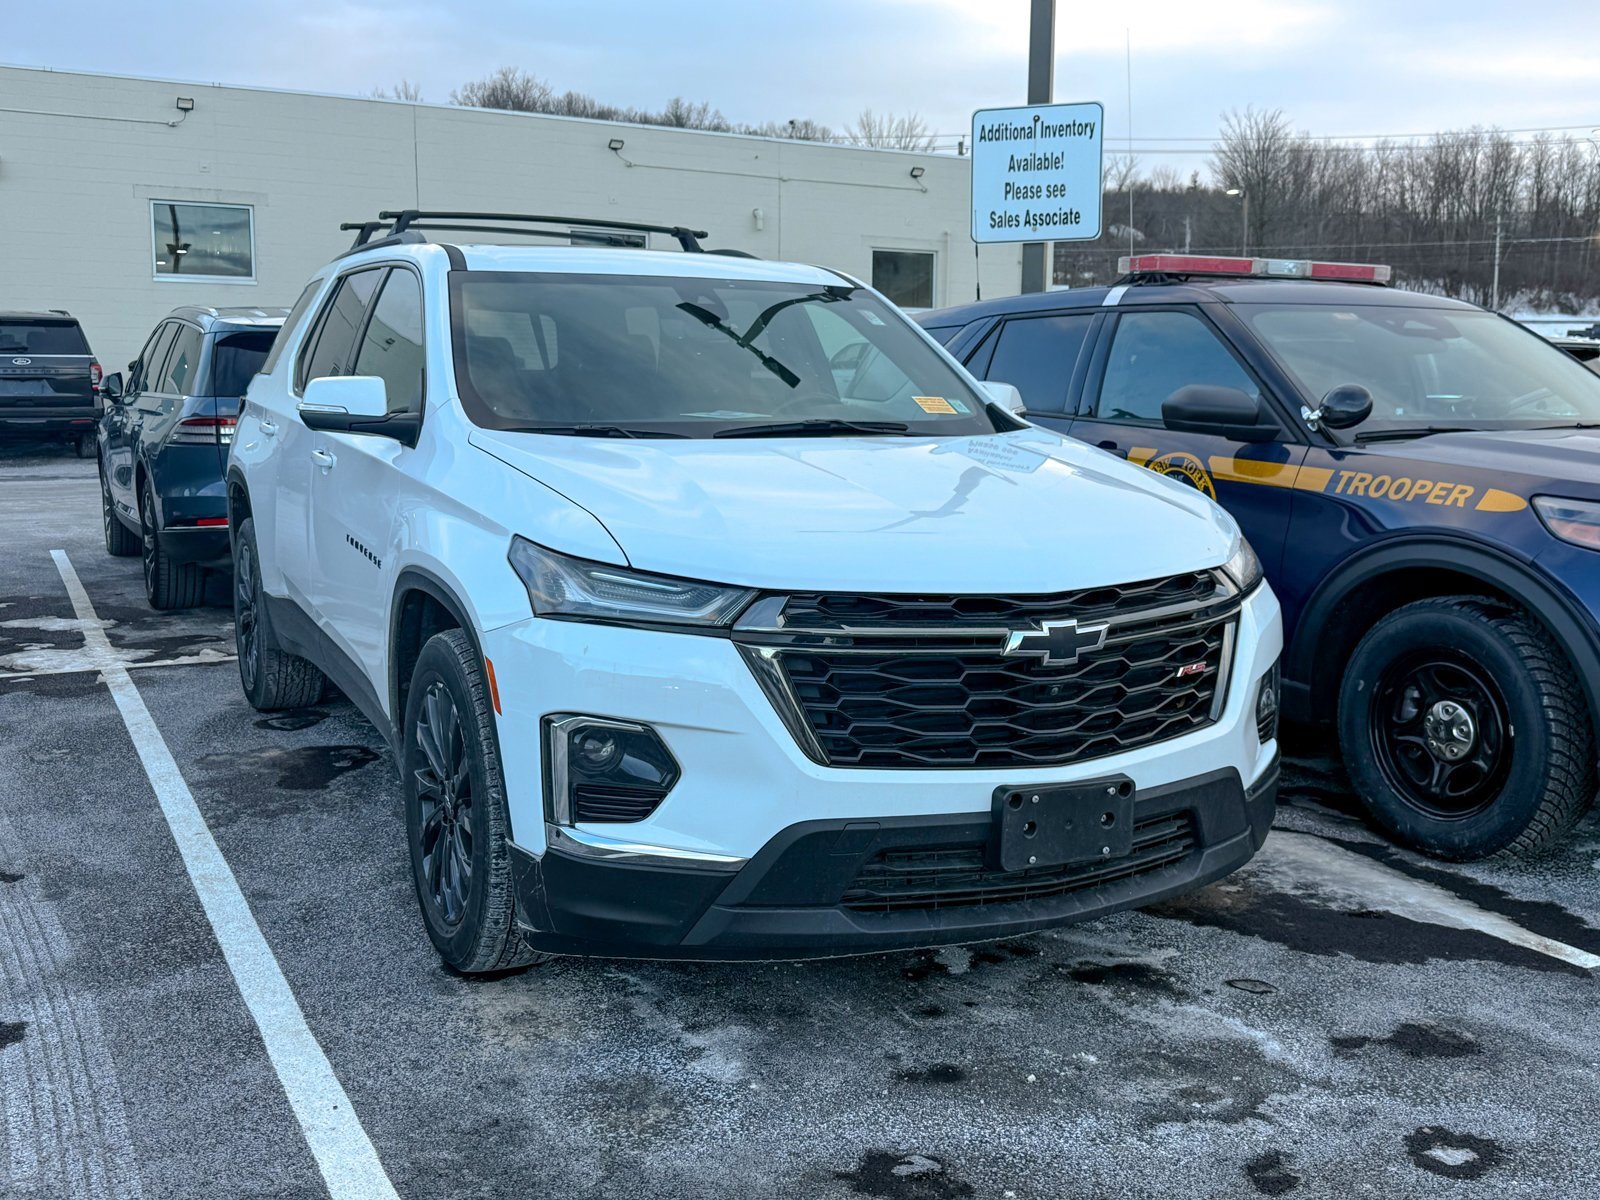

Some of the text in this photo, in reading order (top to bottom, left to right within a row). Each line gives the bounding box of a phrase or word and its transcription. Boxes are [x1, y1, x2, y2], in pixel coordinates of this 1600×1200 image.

[979, 120, 1096, 142] Additional Inventory
[1008, 151, 1065, 172] Available!
[1004, 182, 1066, 201] Please see
[989, 207, 1081, 229] Sales Associate
[1335, 470, 1475, 507] TROOPER
[1176, 661, 1207, 677] RS
